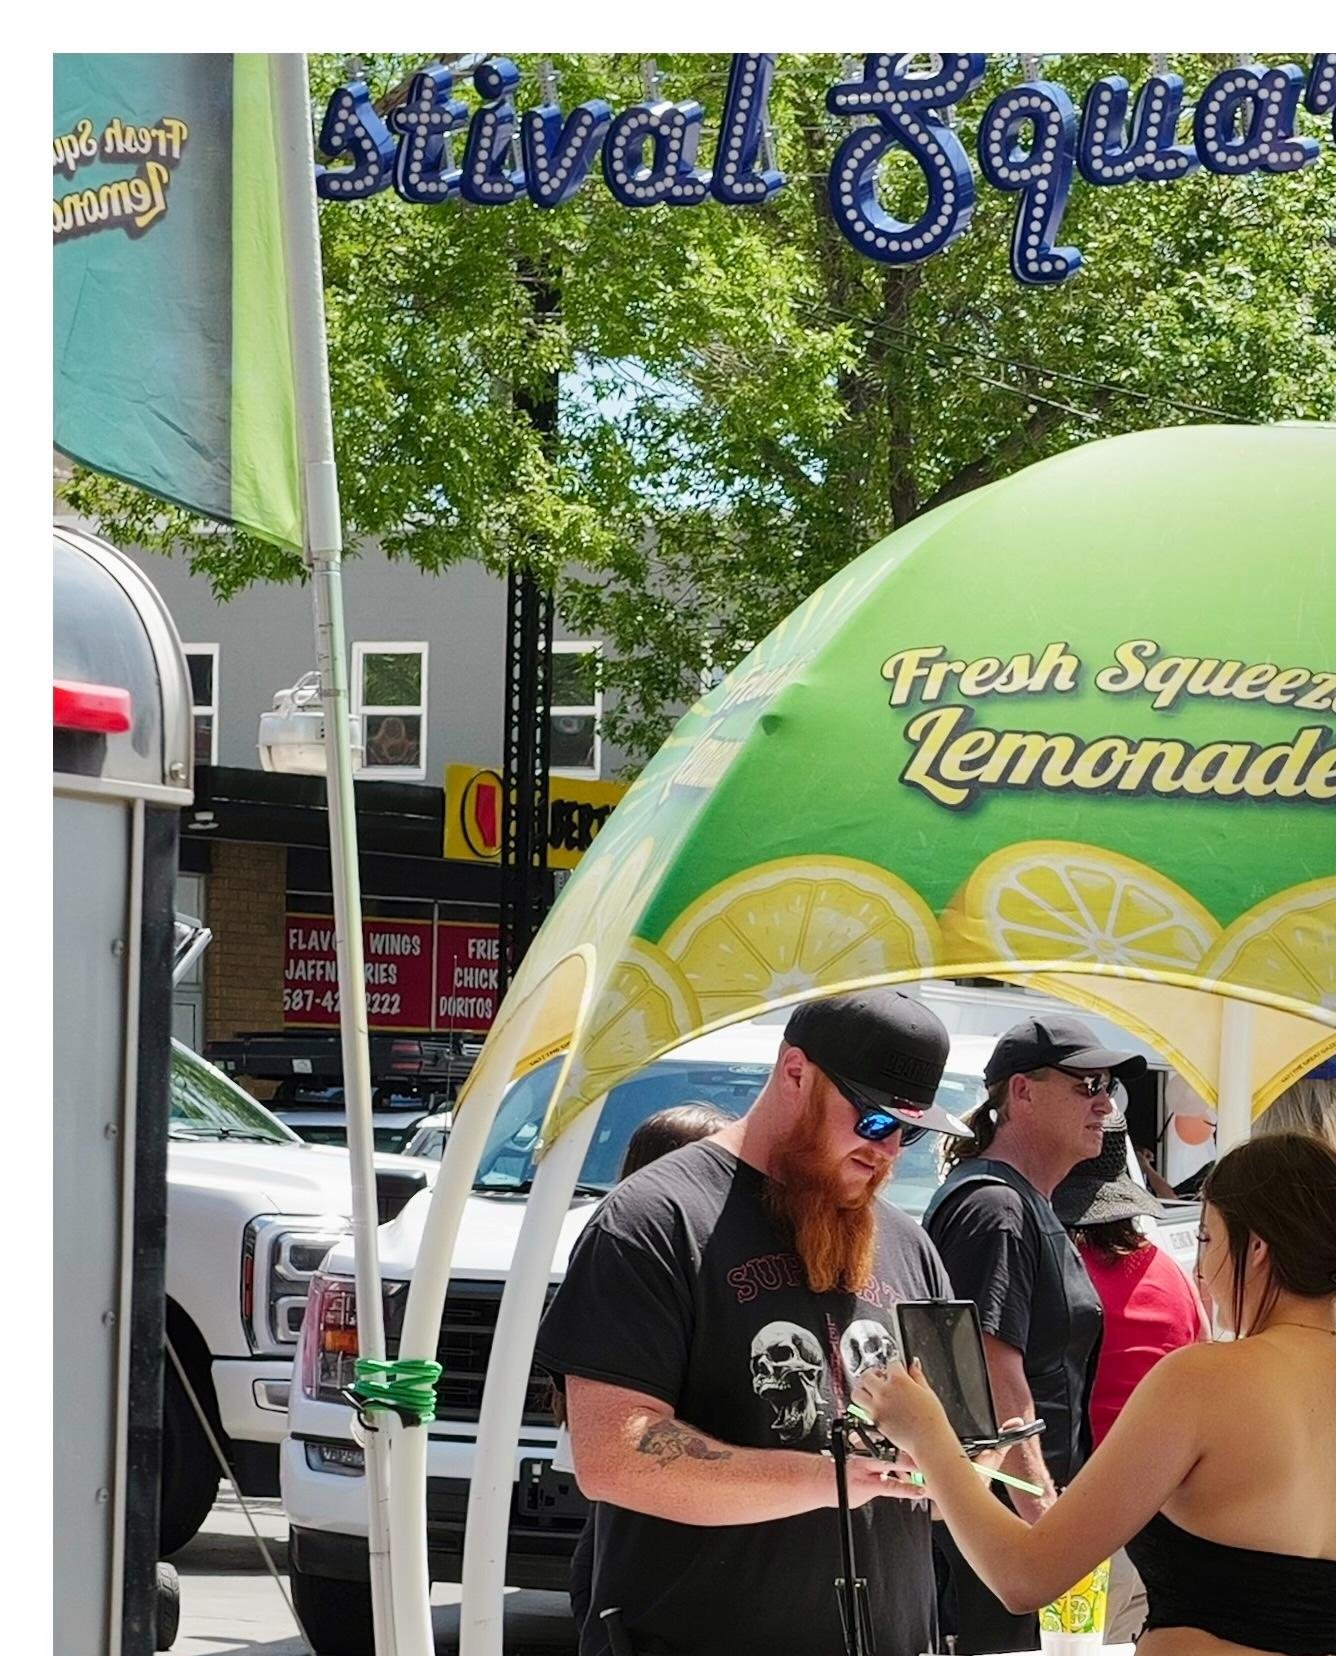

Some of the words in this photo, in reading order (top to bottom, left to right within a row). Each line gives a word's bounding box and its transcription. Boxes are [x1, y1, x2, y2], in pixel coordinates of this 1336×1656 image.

[317, 53, 787, 206] stival
[881, 641, 1081, 708] Fresh
[288, 928, 338, 952] FLAV
[369, 932, 421, 957] WINGS
[467, 938, 500, 961] FRIE
[284, 958, 338, 982] JAFFN
[365, 962, 398, 985] RIES
[454, 967, 500, 991] CHICK
[439, 996, 493, 1020] DORITOS
[727, 1252, 906, 1311] SUPRT
